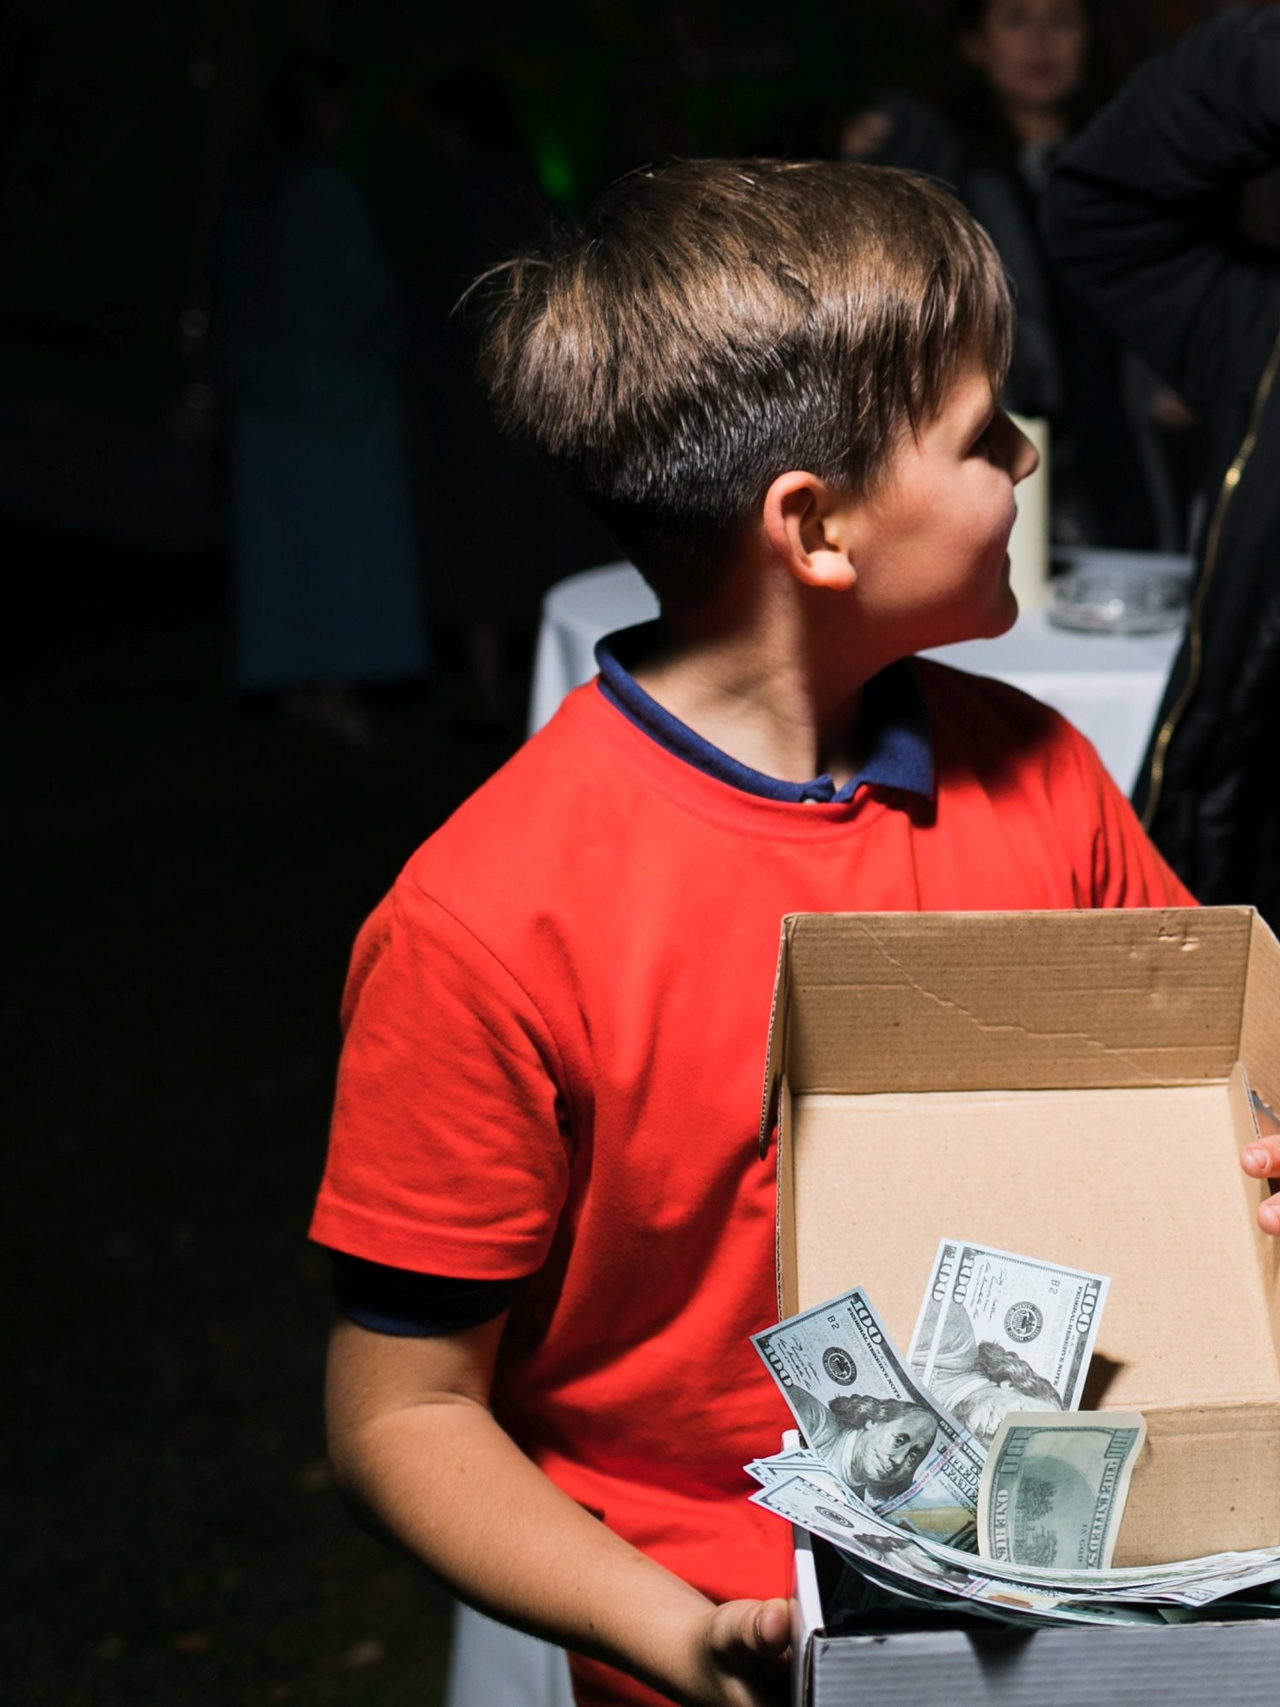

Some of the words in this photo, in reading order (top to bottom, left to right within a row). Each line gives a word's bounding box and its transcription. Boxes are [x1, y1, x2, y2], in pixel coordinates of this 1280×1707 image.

[953, 1257, 976, 1305] 100
[850, 1299, 883, 1346] 100
[1075, 1283, 1101, 1334] 100
